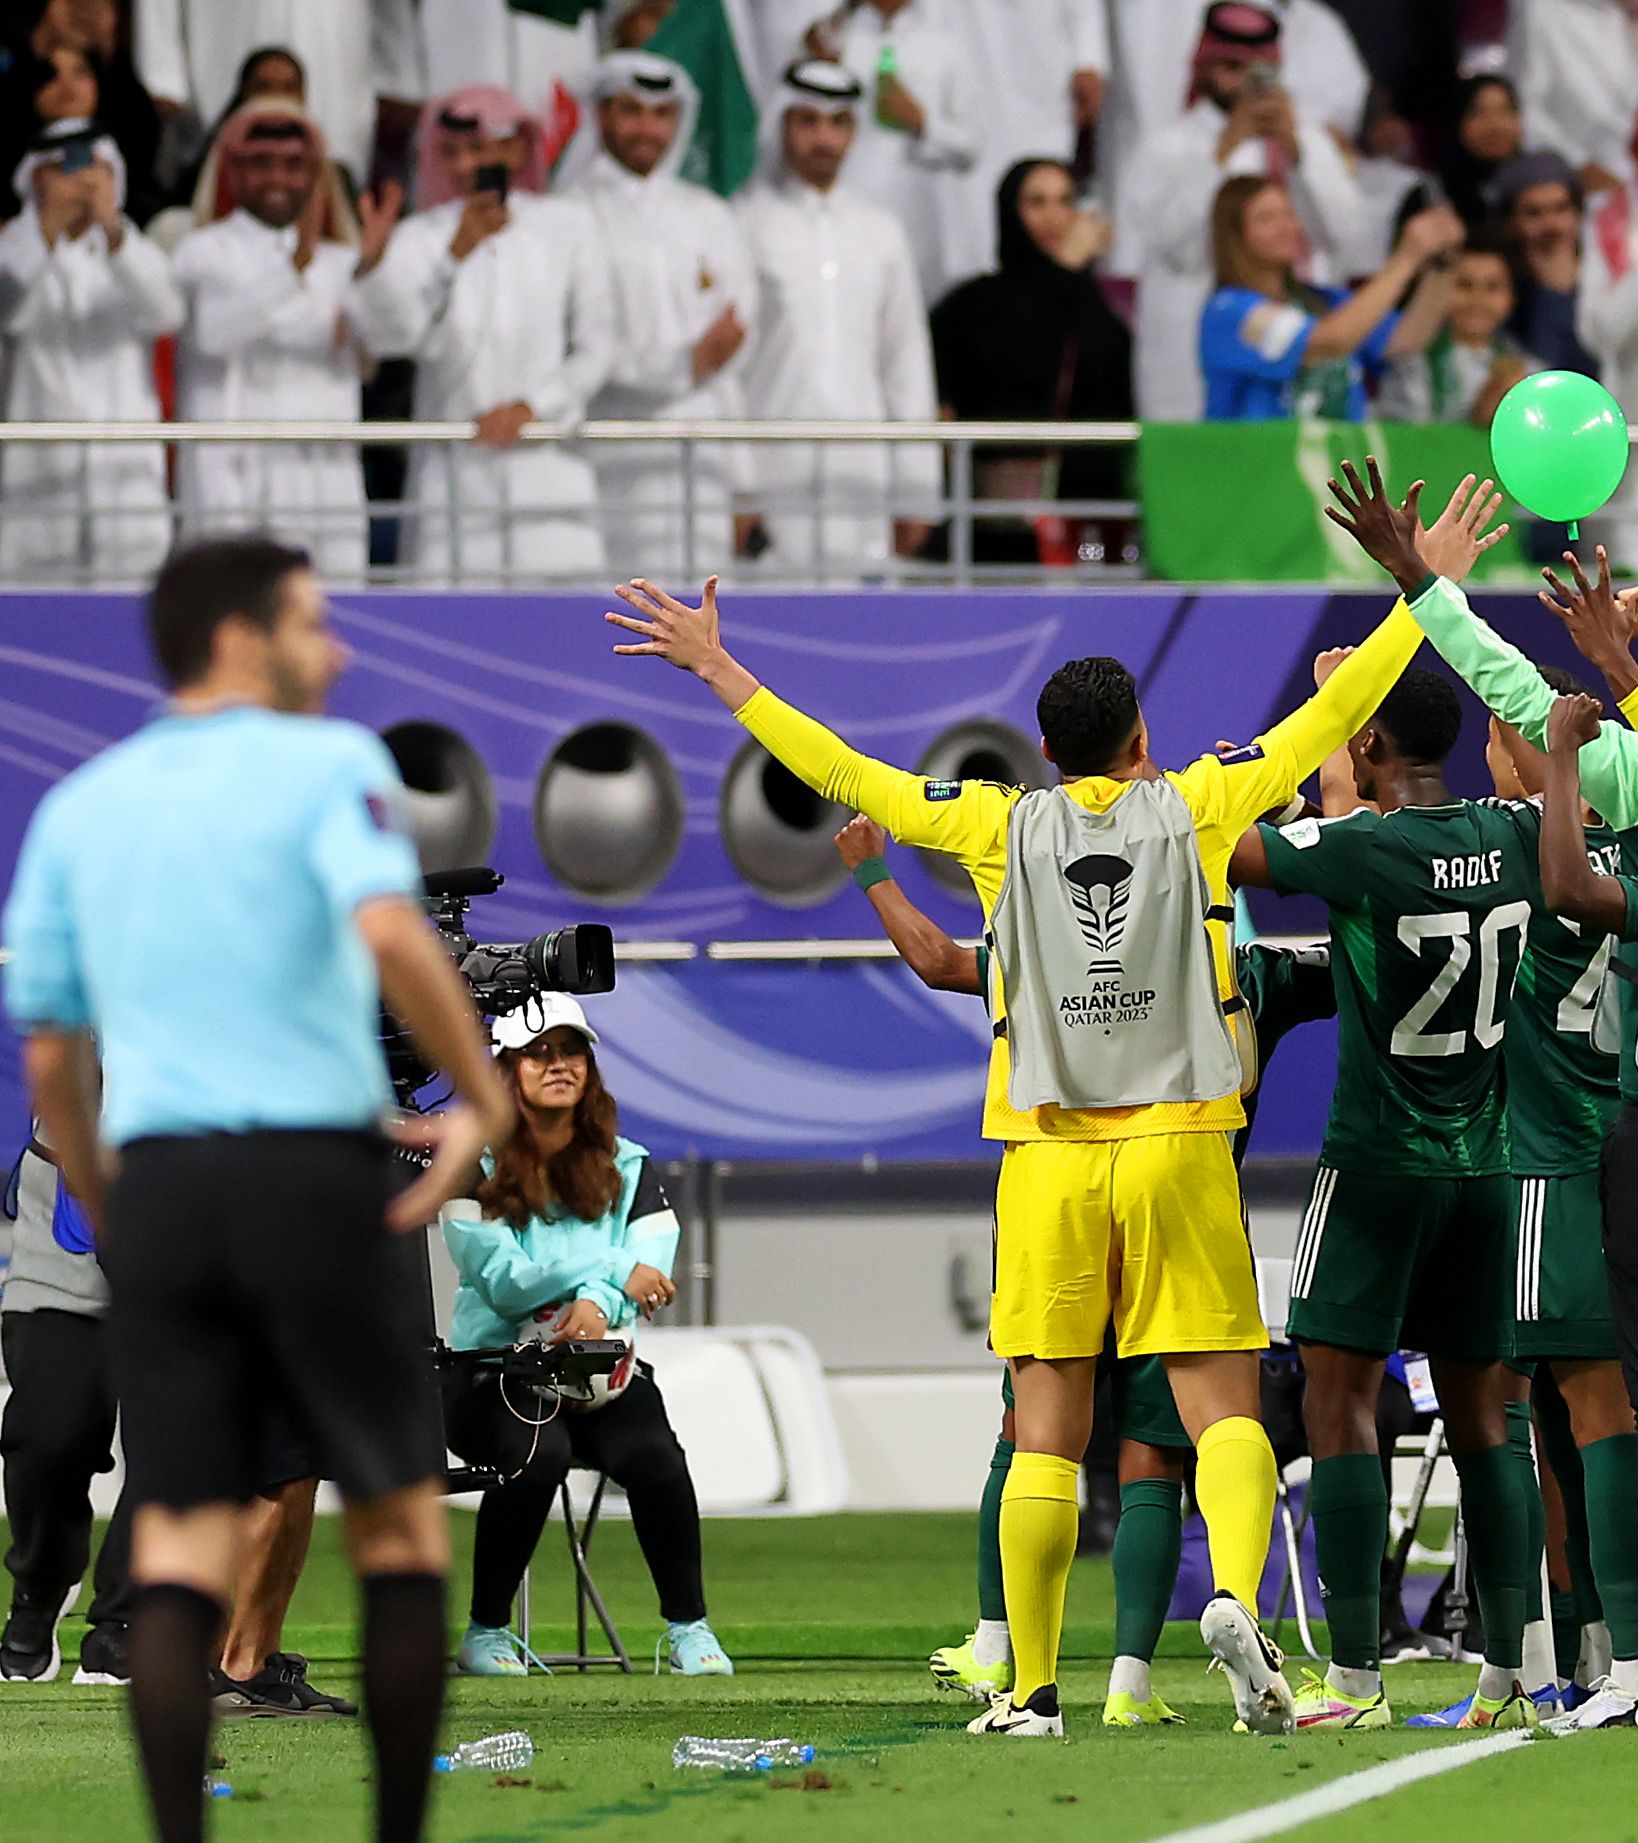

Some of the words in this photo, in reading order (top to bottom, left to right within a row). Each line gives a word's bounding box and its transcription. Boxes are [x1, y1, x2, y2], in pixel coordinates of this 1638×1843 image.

[1431, 849, 1502, 889] RADIF
[1092, 981, 1120, 993] AFC
[1391, 900, 1531, 1057] 20
[1059, 994, 1116, 1011] ASIAN
[1120, 990, 1156, 1008] CUP
[1064, 1012, 1112, 1028] QATAR
[1116, 1007, 1148, 1023] 2023
